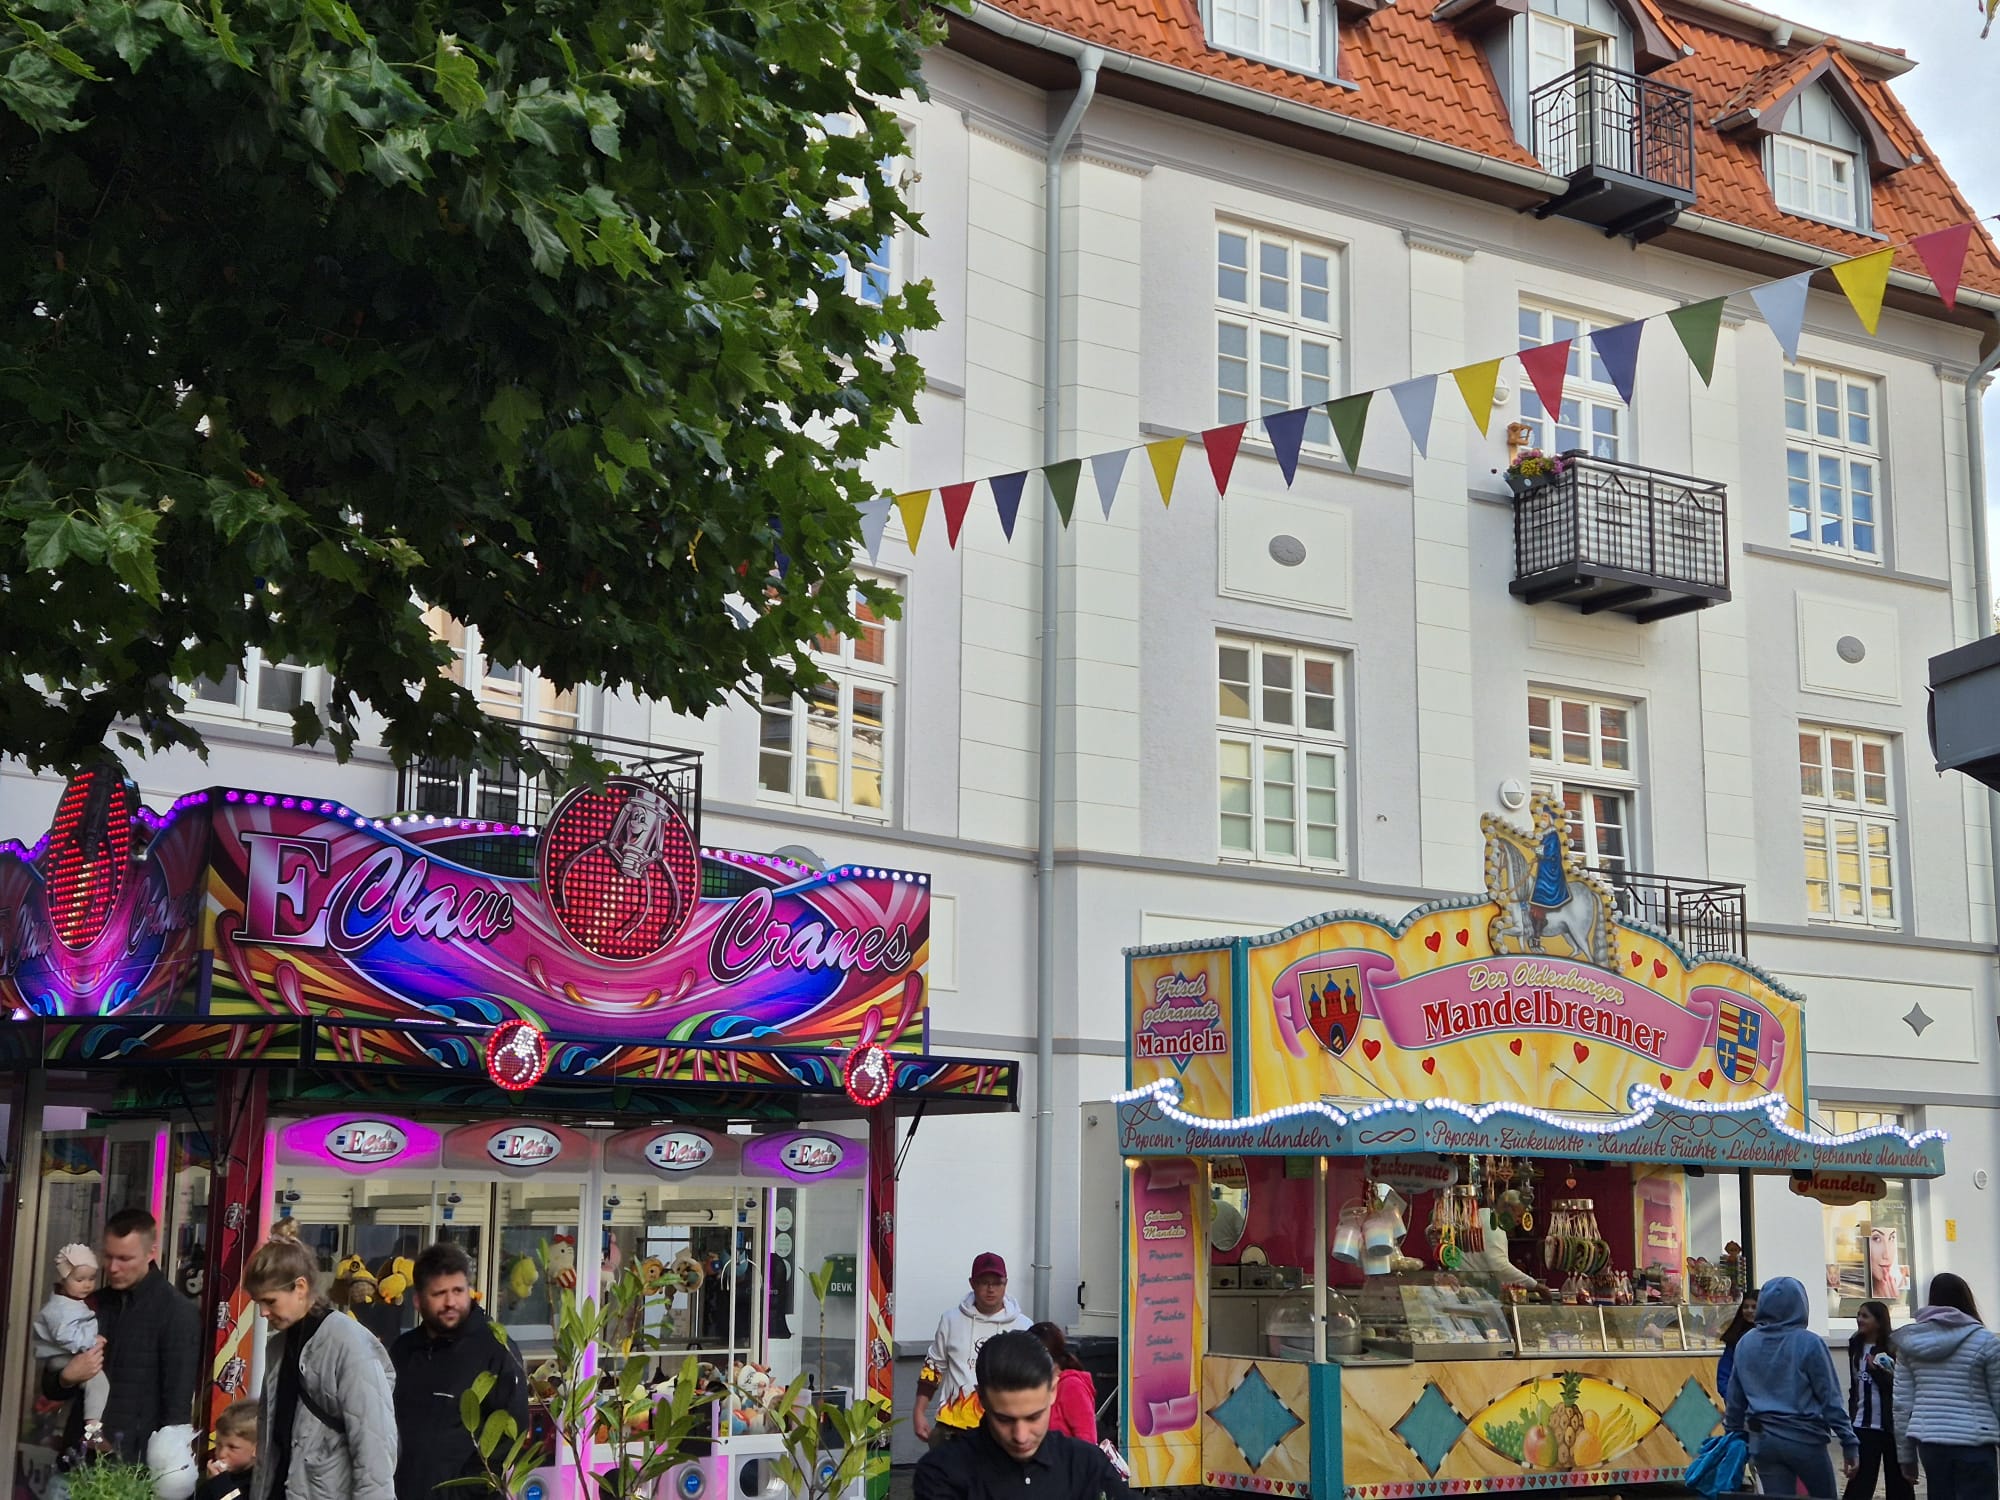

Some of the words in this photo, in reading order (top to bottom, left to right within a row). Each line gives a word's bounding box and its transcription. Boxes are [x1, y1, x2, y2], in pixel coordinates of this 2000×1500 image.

[709, 887, 911, 983] Cranes
[1156, 973, 1206, 1002] Frisch
[1468, 962, 1508, 991] Der
[1512, 962, 1625, 1005] Oldenburger
[1143, 1000, 1218, 1030] gebrannte
[1421, 989, 1667, 1057] Mandelbrenner
[1136, 1028, 1226, 1057] Mandeln
[1121, 1126, 1175, 1151] Popcorn
[1185, 1126, 1254, 1154] Gebrannte
[1257, 1126, 1331, 1148] Mandeln
[1432, 1120, 1490, 1150] Popcorn
[1597, 1133, 1667, 1156] Kandierte
[1727, 1138, 1801, 1167] Liebesäpfel
[1812, 1144, 1873, 1169] Gebrannte
[1875, 1144, 1929, 1167] Mandeln
[831, 1283, 852, 1292] DEVK
